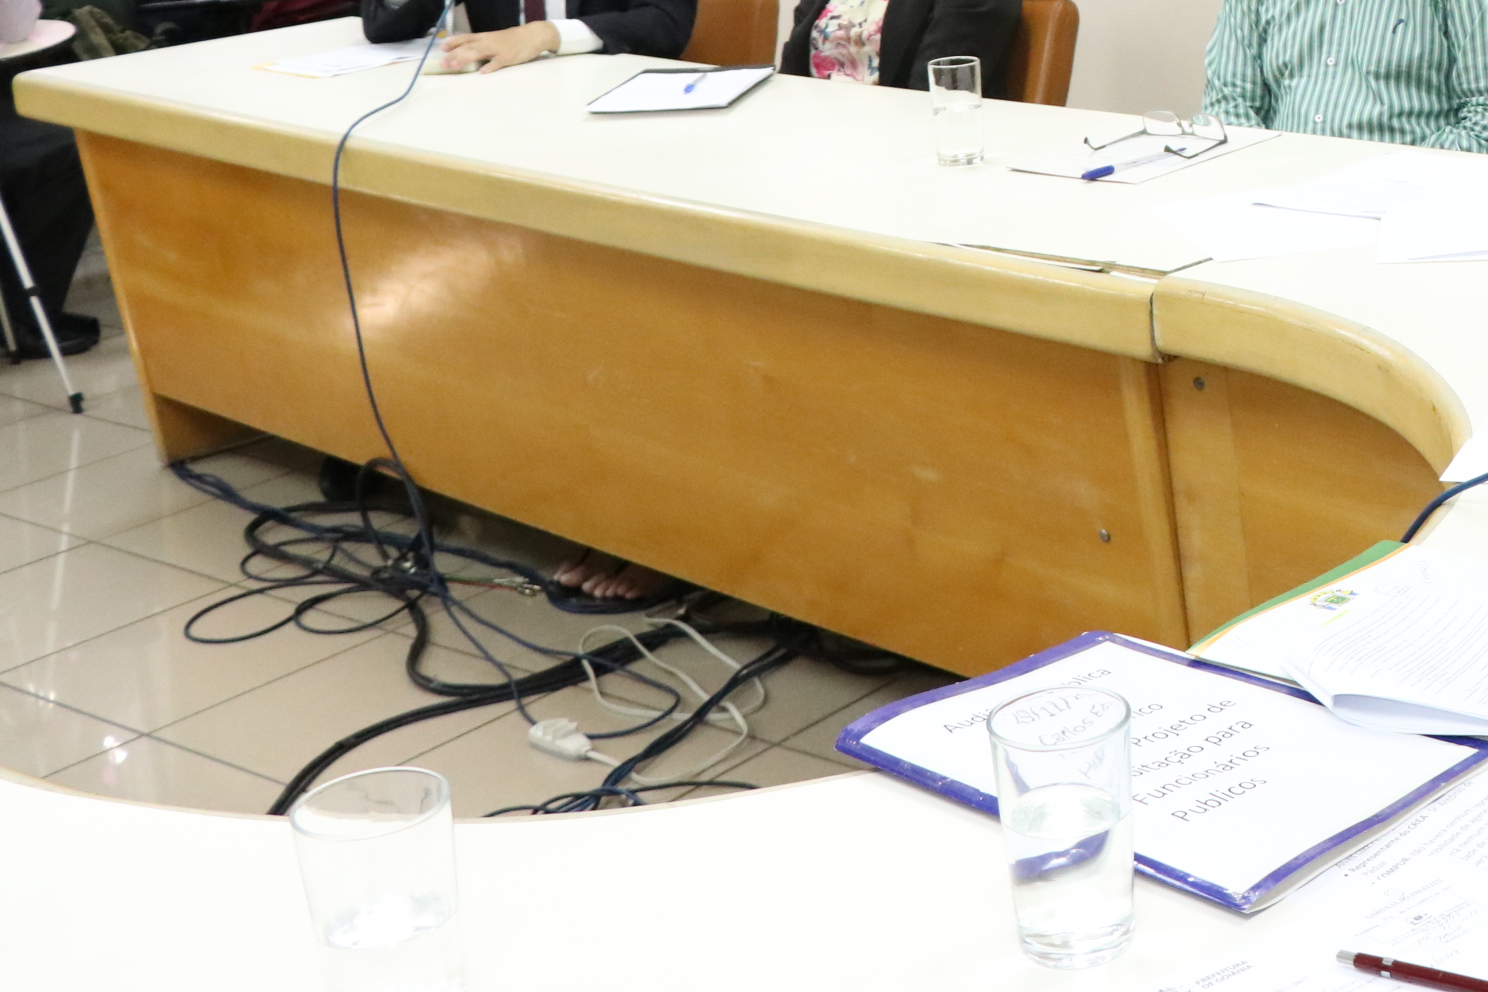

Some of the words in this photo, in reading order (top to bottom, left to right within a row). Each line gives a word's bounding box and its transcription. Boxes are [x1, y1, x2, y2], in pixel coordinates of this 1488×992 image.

[1130, 713, 1207, 747] Projeto
[1207, 700, 1237, 714] de
[1203, 720, 1254, 747] para
[1131, 744, 1270, 806] Funcionários
[1170, 777, 1267, 822] Publicos
[1348, 836, 1401, 873] Representante
[1407, 814, 1429, 830] CREA
[1194, 959, 1250, 986] PREFEITURA
